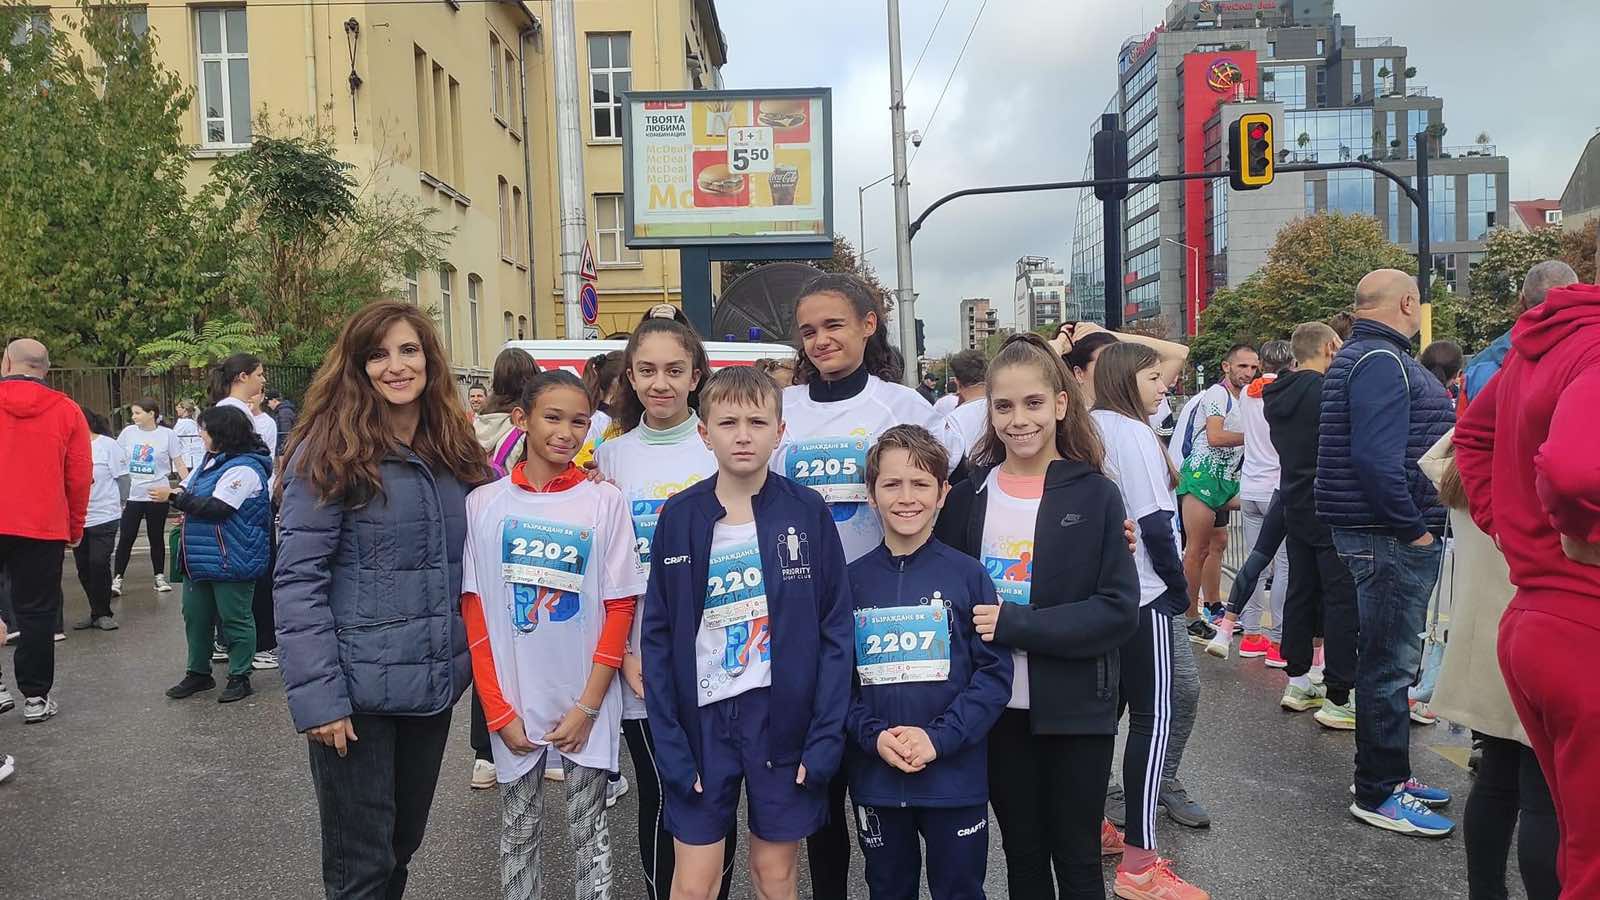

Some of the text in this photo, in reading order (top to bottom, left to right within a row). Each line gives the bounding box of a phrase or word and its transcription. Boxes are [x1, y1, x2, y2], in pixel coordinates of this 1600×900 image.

[645, 115, 686, 124] ТВОЯТА
[645, 124, 687, 132] ЛЮБИМА
[795, 458, 857, 478] 2205
[511, 537, 578, 564] 2202
[664, 556, 688, 565] CRAFT
[782, 567, 811, 575] PRIORITY
[708, 567, 762, 597] 220
[866, 631, 936, 655] 2207
